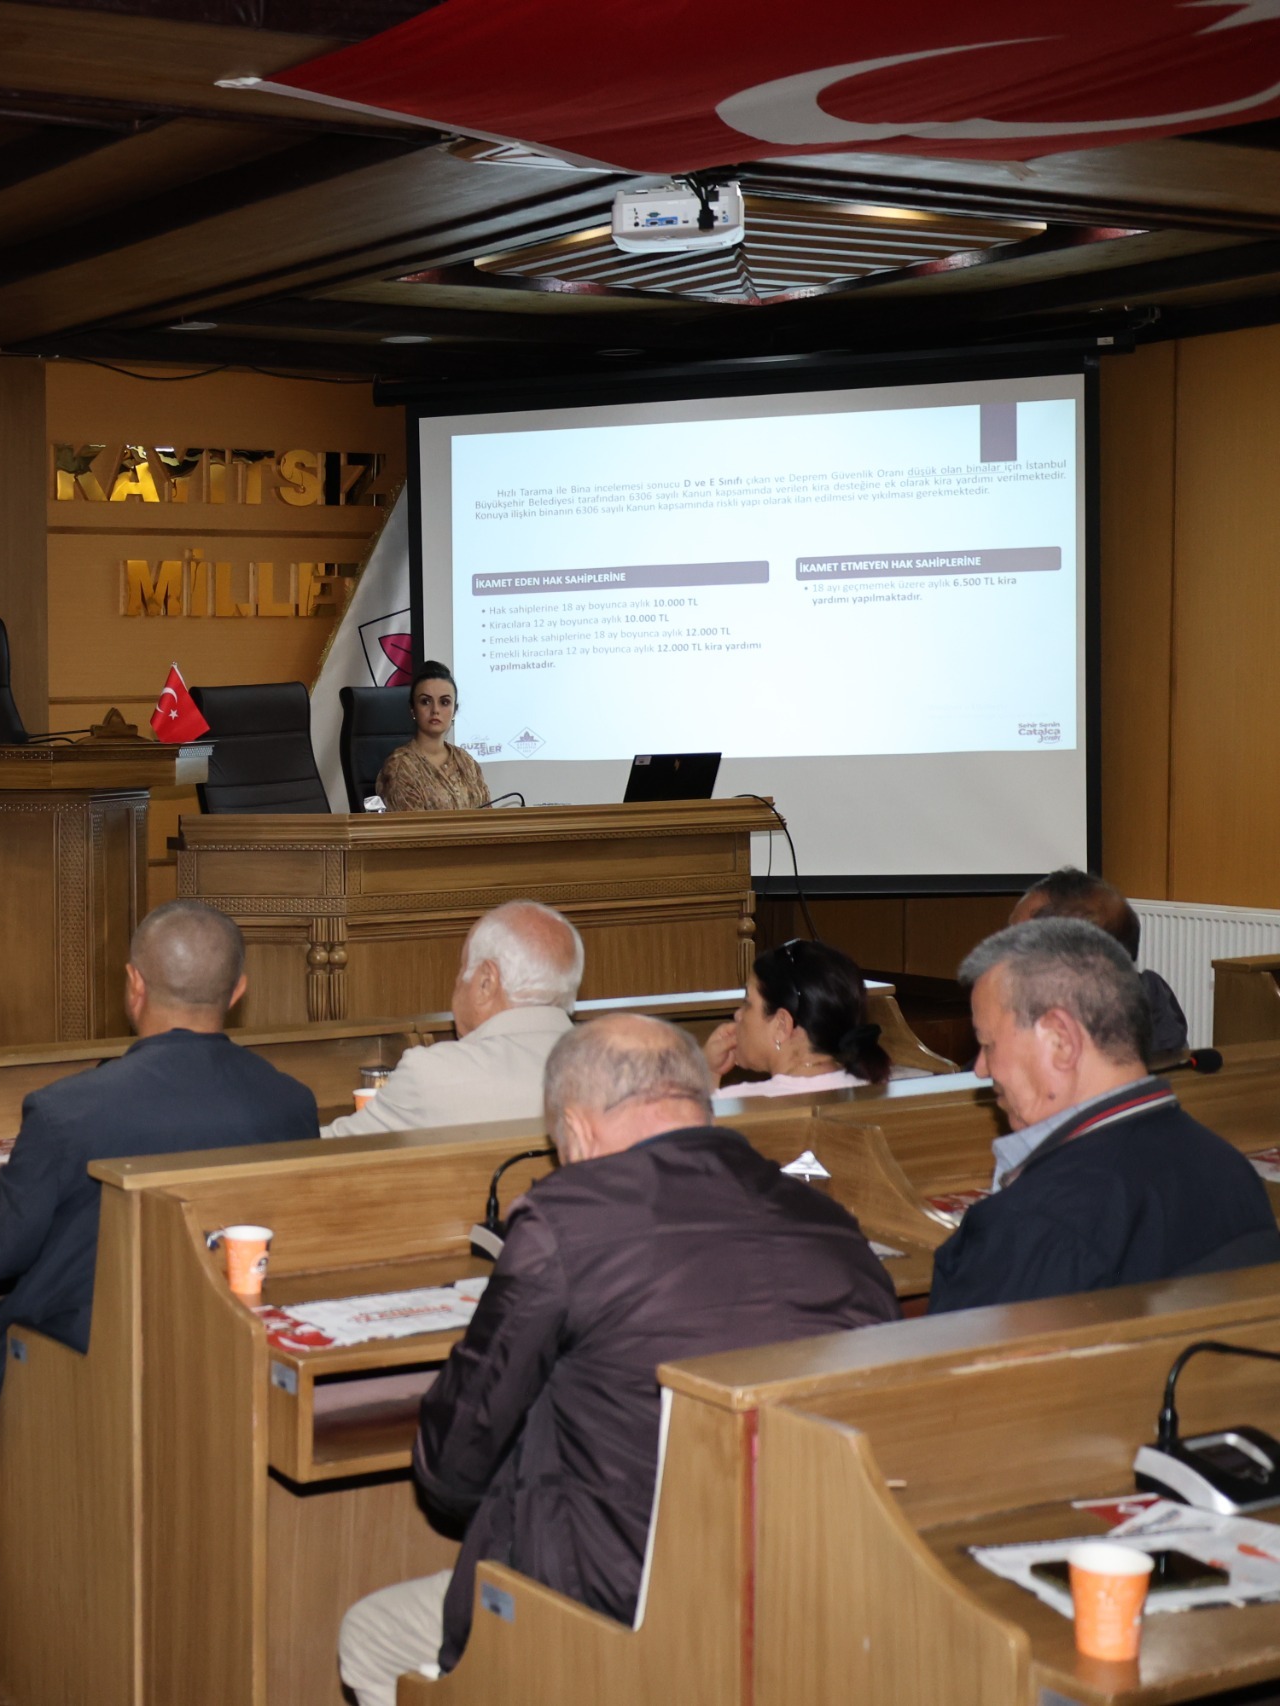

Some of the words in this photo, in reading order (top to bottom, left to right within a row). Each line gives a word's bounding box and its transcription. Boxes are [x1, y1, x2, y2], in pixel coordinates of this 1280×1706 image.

[53, 444, 387, 507] KAYITSIZ
[496, 488, 517, 498] Hızlı
[519, 488, 553, 496] Tarama
[556, 486, 568, 495] ile
[570, 485, 591, 494] Bina
[646, 482, 680, 490] sonucu
[683, 479, 692, 488] D
[709, 478, 715, 487] E
[718, 477, 743, 486] Sınıfı
[788, 474, 827, 484] Deprem
[830, 470, 873, 480] Güvenlik
[876, 469, 904, 478] Oranı
[907, 466, 938, 478] düşük
[939, 466, 964, 475] olan
[964, 464, 1002, 474] binalar
[1002, 462, 1023, 474] için
[1024, 460, 1067, 471] İstanbul
[474, 498, 526, 511] Büyükşehir
[527, 495, 575, 507] Belediyesi
[577, 494, 626, 504] tarafından
[628, 492, 652, 501] 6306
[655, 490, 679, 502] sayılı
[682, 490, 712, 499] Kanun
[775, 484, 808, 494] verilen
[811, 483, 830, 492] kira
[884, 479, 896, 488] ek
[899, 478, 930, 488] olarak
[933, 477, 952, 486] kira
[955, 475, 993, 487] yardımı
[474, 511, 509, 521] Konuya
[510, 508, 537, 520] ilişkin
[538, 507, 574, 516] binanın
[575, 505, 599, 514] 6306
[600, 504, 624, 515] sayılı
[626, 503, 656, 512] Kanun
[716, 498, 738, 507] riskli
[740, 498, 761, 508] yapı
[762, 495, 792, 505] olarak
[794, 494, 812, 503] ilan
[799, 562, 839, 573] İKAMET
[840, 561, 889, 571] ETMEYEN
[891, 560, 913, 569] HAK
[915, 556, 981, 568] SAHİPLERİNE
[122, 548, 360, 617] MİLLE
[475, 578, 513, 588] İKAMET
[514, 577, 540, 586] EDEN
[542, 576, 563, 585] HAK
[564, 572, 626, 584] SAHİPLERİNE
[813, 584, 824, 593] 18
[827, 585, 840, 594] ayı
[842, 581, 895, 594] geçmemek
[898, 581, 925, 589] üzere
[927, 579, 950, 590] aylık
[952, 578, 981, 587] 6.500
[983, 577, 995, 586] TL
[997, 577, 1017, 586] kira
[489, 606, 507, 615] Hak
[508, 604, 559, 616] sahiplerine
[562, 603, 573, 612] 18
[575, 604, 586, 614] ay
[588, 602, 627, 613] boyunca
[629, 600, 650, 611] aylık
[653, 598, 685, 608] 10.000
[687, 598, 698, 607] TL
[811, 594, 849, 605] yardımı
[489, 620, 531, 630] Kiracılara
[533, 619, 545, 628] 12
[546, 620, 557, 629] ay
[559, 618, 599, 629] boyunca
[601, 616, 622, 627] aylık
[624, 614, 656, 624] 10.000
[658, 614, 669, 623] TL
[489, 634, 520, 644] Emekli
[521, 634, 539, 643] hak
[540, 632, 591, 644] sahiplerine
[594, 631, 606, 640] 18
[607, 633, 618, 642] ay
[620, 631, 659, 641] boyunca
[661, 628, 683, 640] aylık
[685, 627, 718, 637] 12.000
[719, 627, 731, 636] TL
[489, 649, 520, 659] Emekli
[521, 648, 563, 658] kiracılara
[566, 647, 577, 656] 12
[579, 649, 590, 658] ay
[592, 647, 631, 657] boyunca
[633, 645, 654, 656] aylık
[657, 643, 689, 653] 12.000
[691, 643, 702, 652] TL
[704, 642, 723, 651] kira
[724, 641, 761, 653] yardımı
